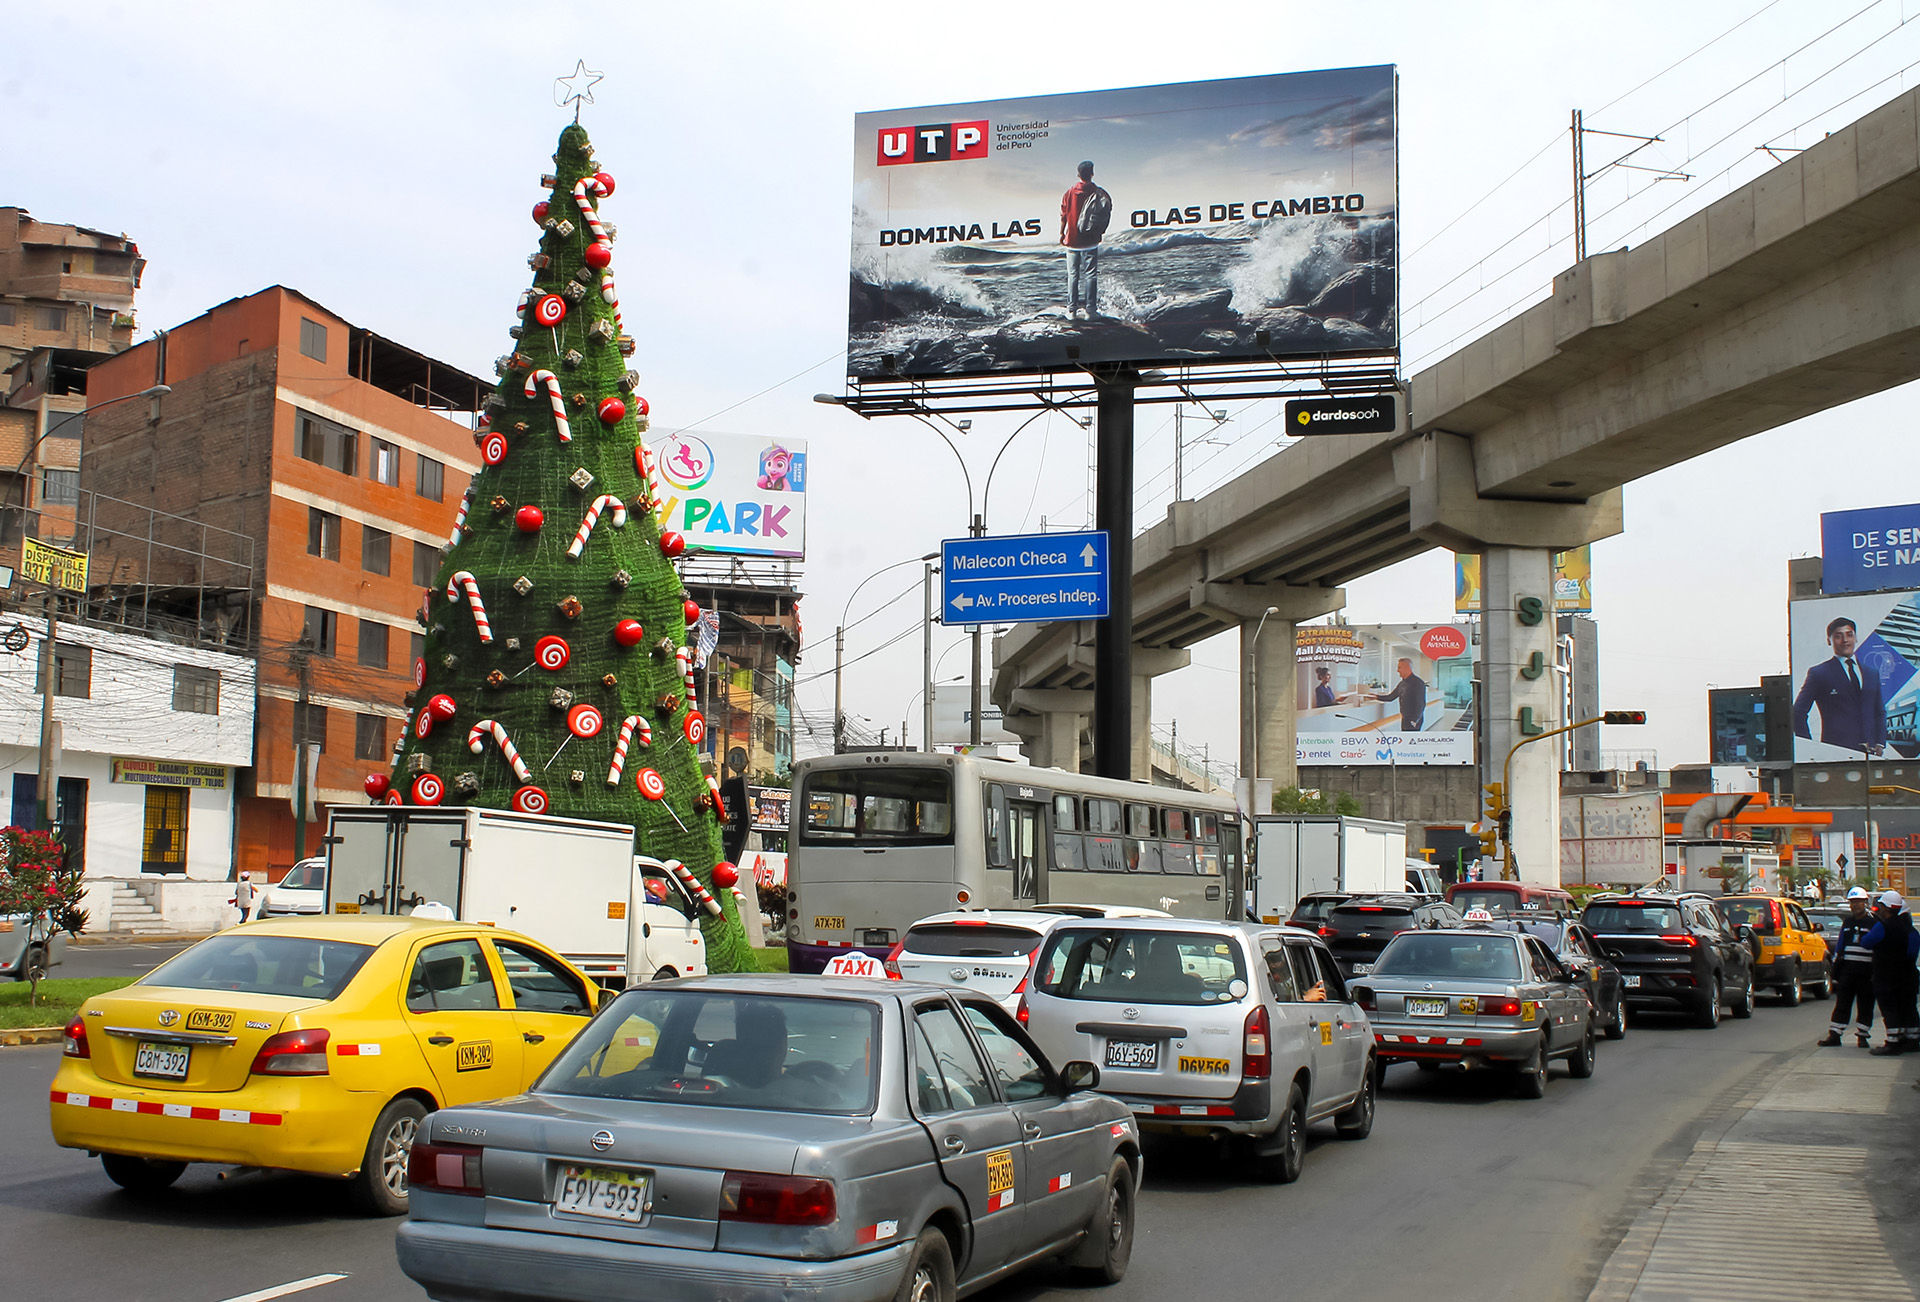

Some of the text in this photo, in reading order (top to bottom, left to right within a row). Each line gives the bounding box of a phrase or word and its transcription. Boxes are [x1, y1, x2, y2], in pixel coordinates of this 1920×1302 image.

[997, 121, 1049, 132] Universidad
[883, 128, 981, 157] UTP
[997, 130, 1049, 142] Tecnológica
[996, 141, 1032, 151] del Perú
[1131, 194, 1364, 228] OLAS DE CAMBIO
[880, 218, 1042, 247] DOMINA LAS
[1312, 408, 1380, 421] dardosooh
[683, 498, 792, 538] PARK
[1853, 531, 1880, 549] DE
[26, 549, 85, 572] DISPONIBLE
[953, 551, 1067, 570] Malecon Checa
[1863, 551, 1889, 568] SE
[65, 571, 84, 590] 016
[1565, 580, 1578, 588] 24
[976, 589, 1101, 607] Av. Proceres Indep.
[1296, 638, 1317, 646] IDOS
[1325, 637, 1364, 649] SEGUROS
[1315, 646, 1361, 658] Aventura
[1297, 655, 1312, 663] Juan
[1323, 654, 1359, 664] Lurigancho
[1380, 737, 1398, 745] BCP
[1340, 750, 1362, 758] Claro
[123, 760, 148, 772] ALQUILER
[1019, 787, 1034, 799] Bajada
[1467, 912, 1488, 920] TAXI
[815, 918, 845, 929] A7X-781
[833, 959, 874, 976] TAXI
[192, 1011, 232, 1028] C8M-392
[246, 1020, 272, 1030] YARIS
[461, 1045, 491, 1065] C8M-392
[1108, 1047, 1154, 1062] D6Y-569
[138, 1050, 186, 1073] C8M-392
[441, 1126, 487, 1137] SENTRA
[993, 1154, 1007, 1163] PERU
[562, 1177, 642, 1213] F9Y-593
